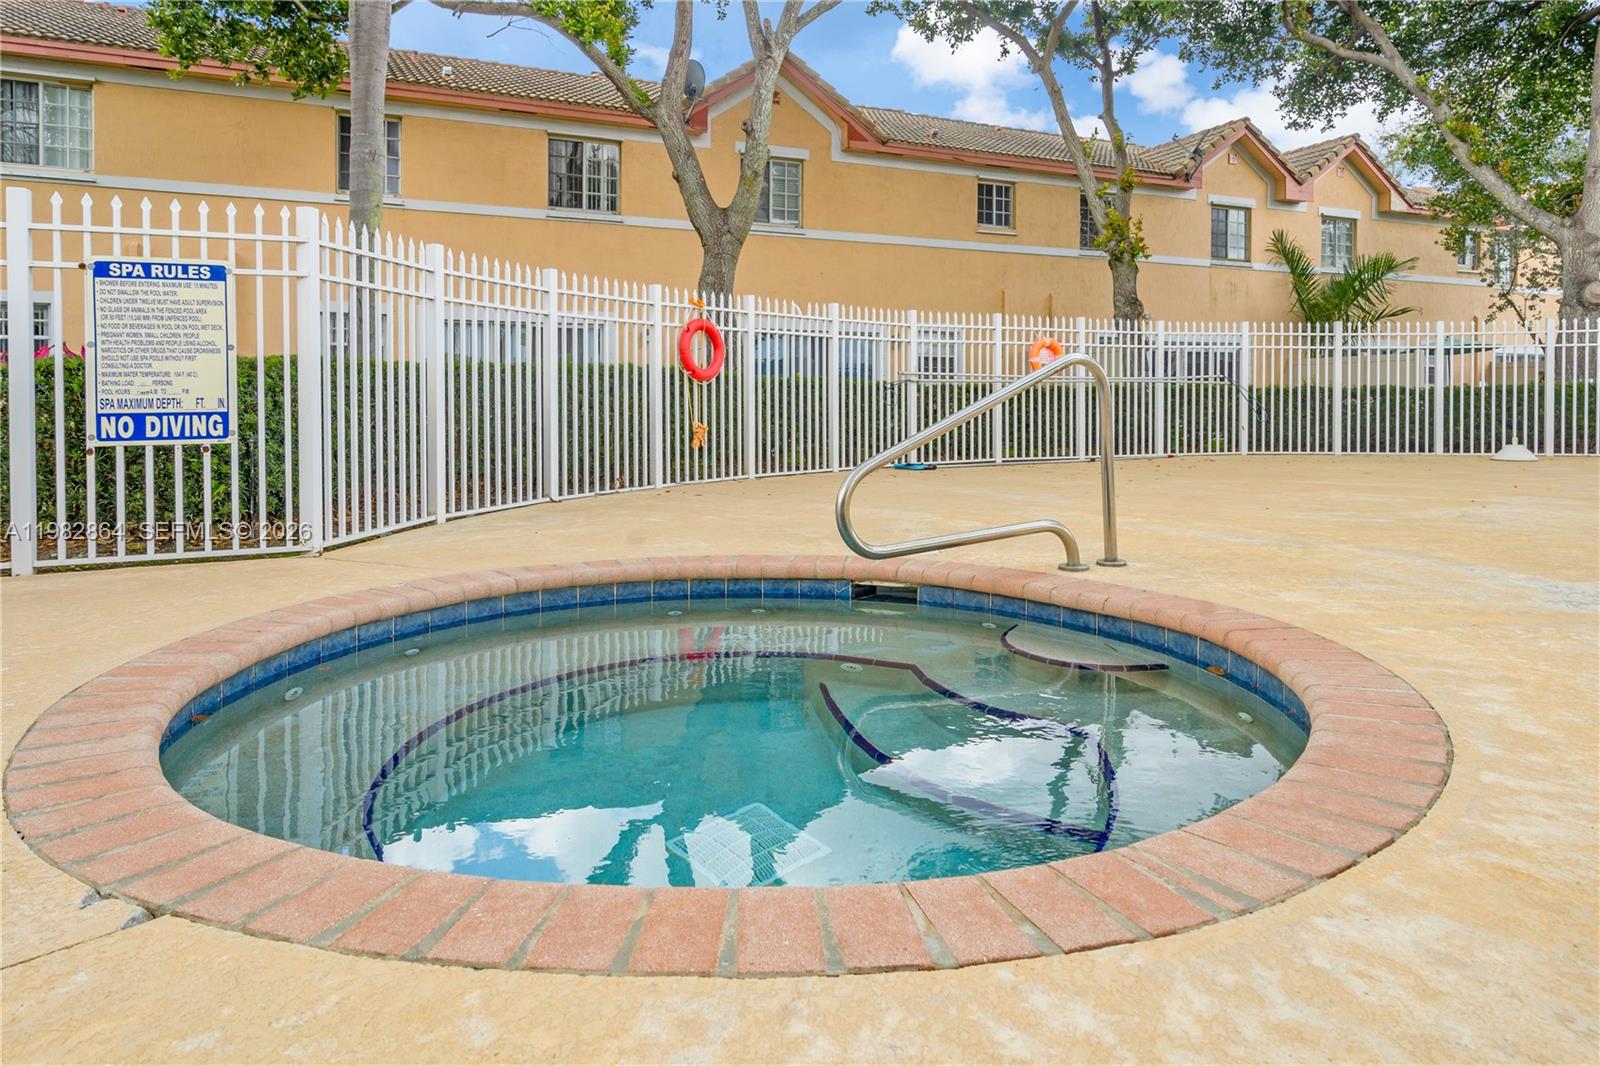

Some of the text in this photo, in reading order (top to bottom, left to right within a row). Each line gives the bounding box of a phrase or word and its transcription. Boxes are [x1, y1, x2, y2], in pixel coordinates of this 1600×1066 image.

[109, 263, 211, 279] SPA RULES
[100, 398, 115, 409] SPA
[117, 398, 154, 409] MAXIMUM
[156, 398, 183, 409] DEPTH:
[101, 415, 223, 438] NO DIVING
